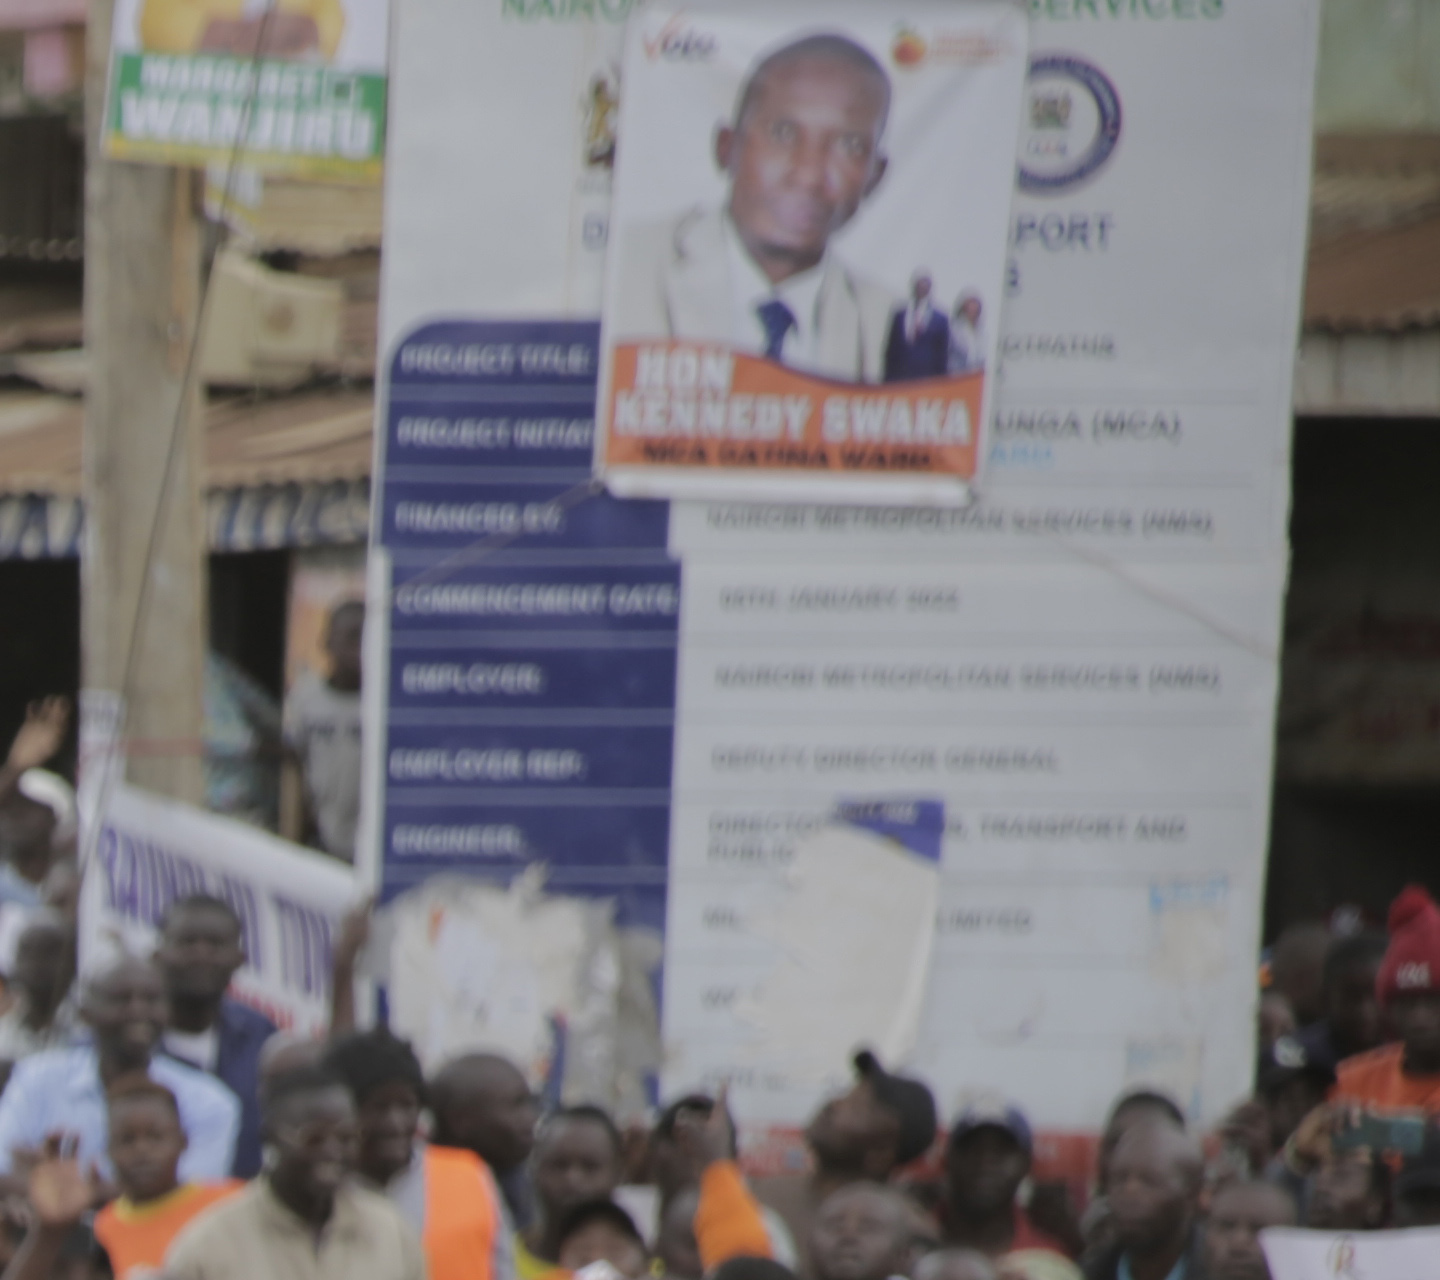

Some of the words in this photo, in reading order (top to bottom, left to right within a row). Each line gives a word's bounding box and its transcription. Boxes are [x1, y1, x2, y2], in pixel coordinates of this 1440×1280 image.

[121, 91, 374, 160] WANJIRU
[634, 345, 735, 392] HON
[614, 389, 813, 441] KENNEDY
[821, 396, 972, 446] SWAKA
[994, 411, 1083, 439] UNGA
[945, 747, 1059, 773] GENERAL
